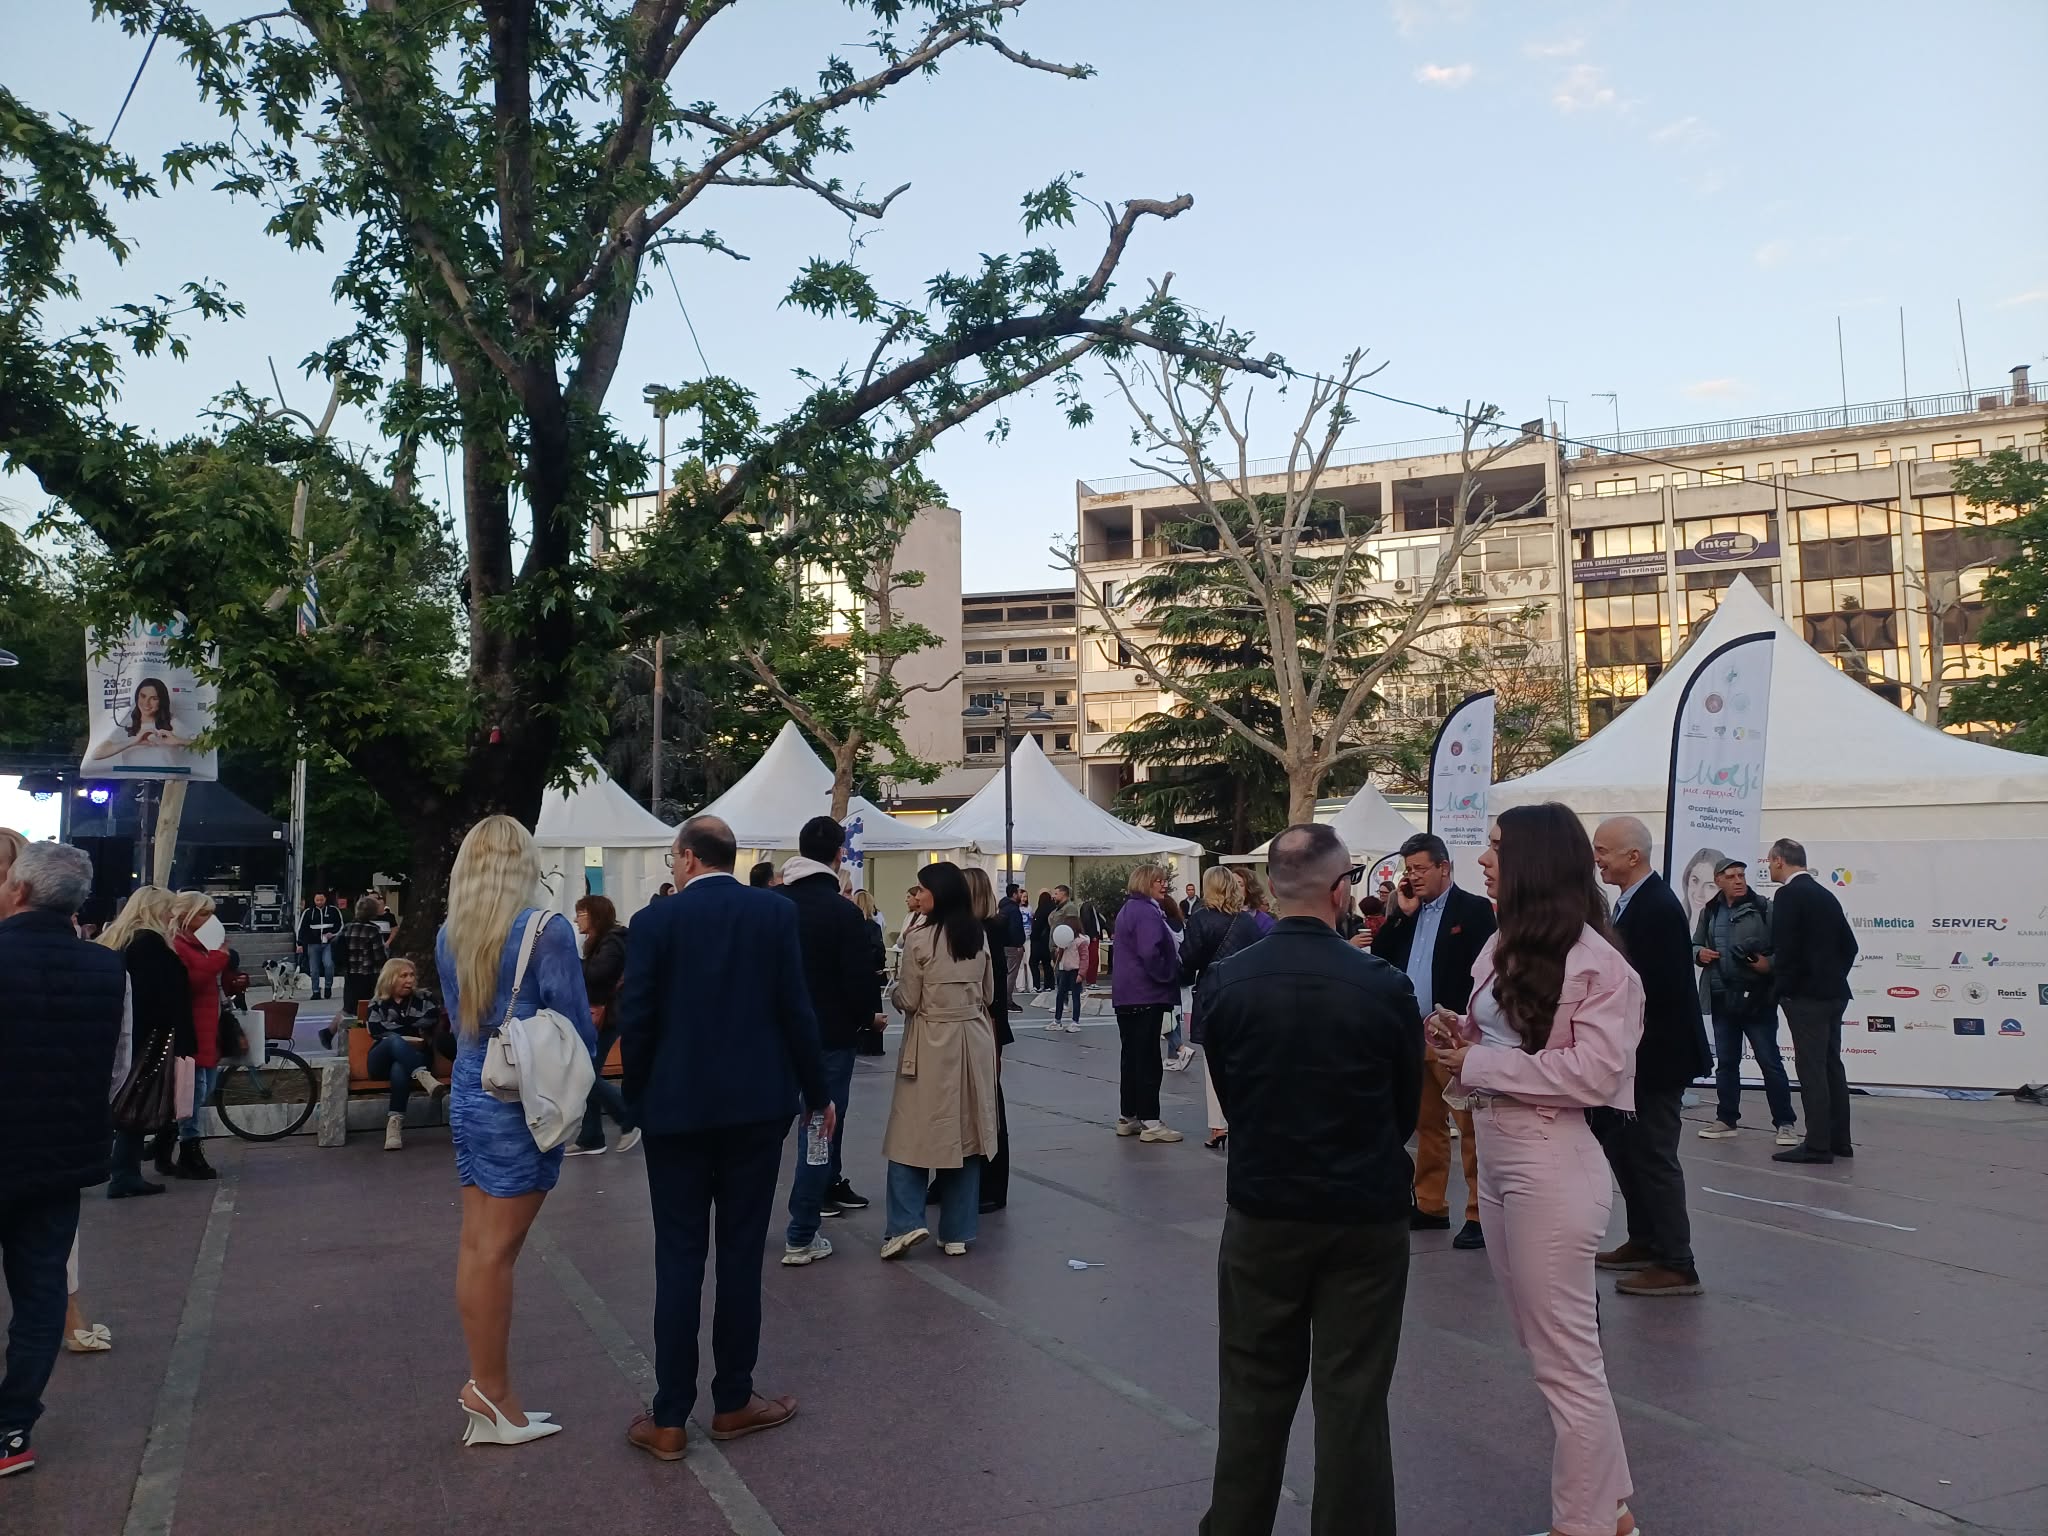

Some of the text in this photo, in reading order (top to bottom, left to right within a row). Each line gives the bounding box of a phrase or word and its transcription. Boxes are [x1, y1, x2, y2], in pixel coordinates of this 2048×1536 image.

[1700, 539, 1735, 550] inter
[1620, 566, 1665, 575] interlingua
[103, 678, 132, 688] 23-26
[1852, 917, 1915, 928] WinMedica
[1932, 918, 2004, 930] SERVIER
[1998, 988, 2027, 997] Rontis
